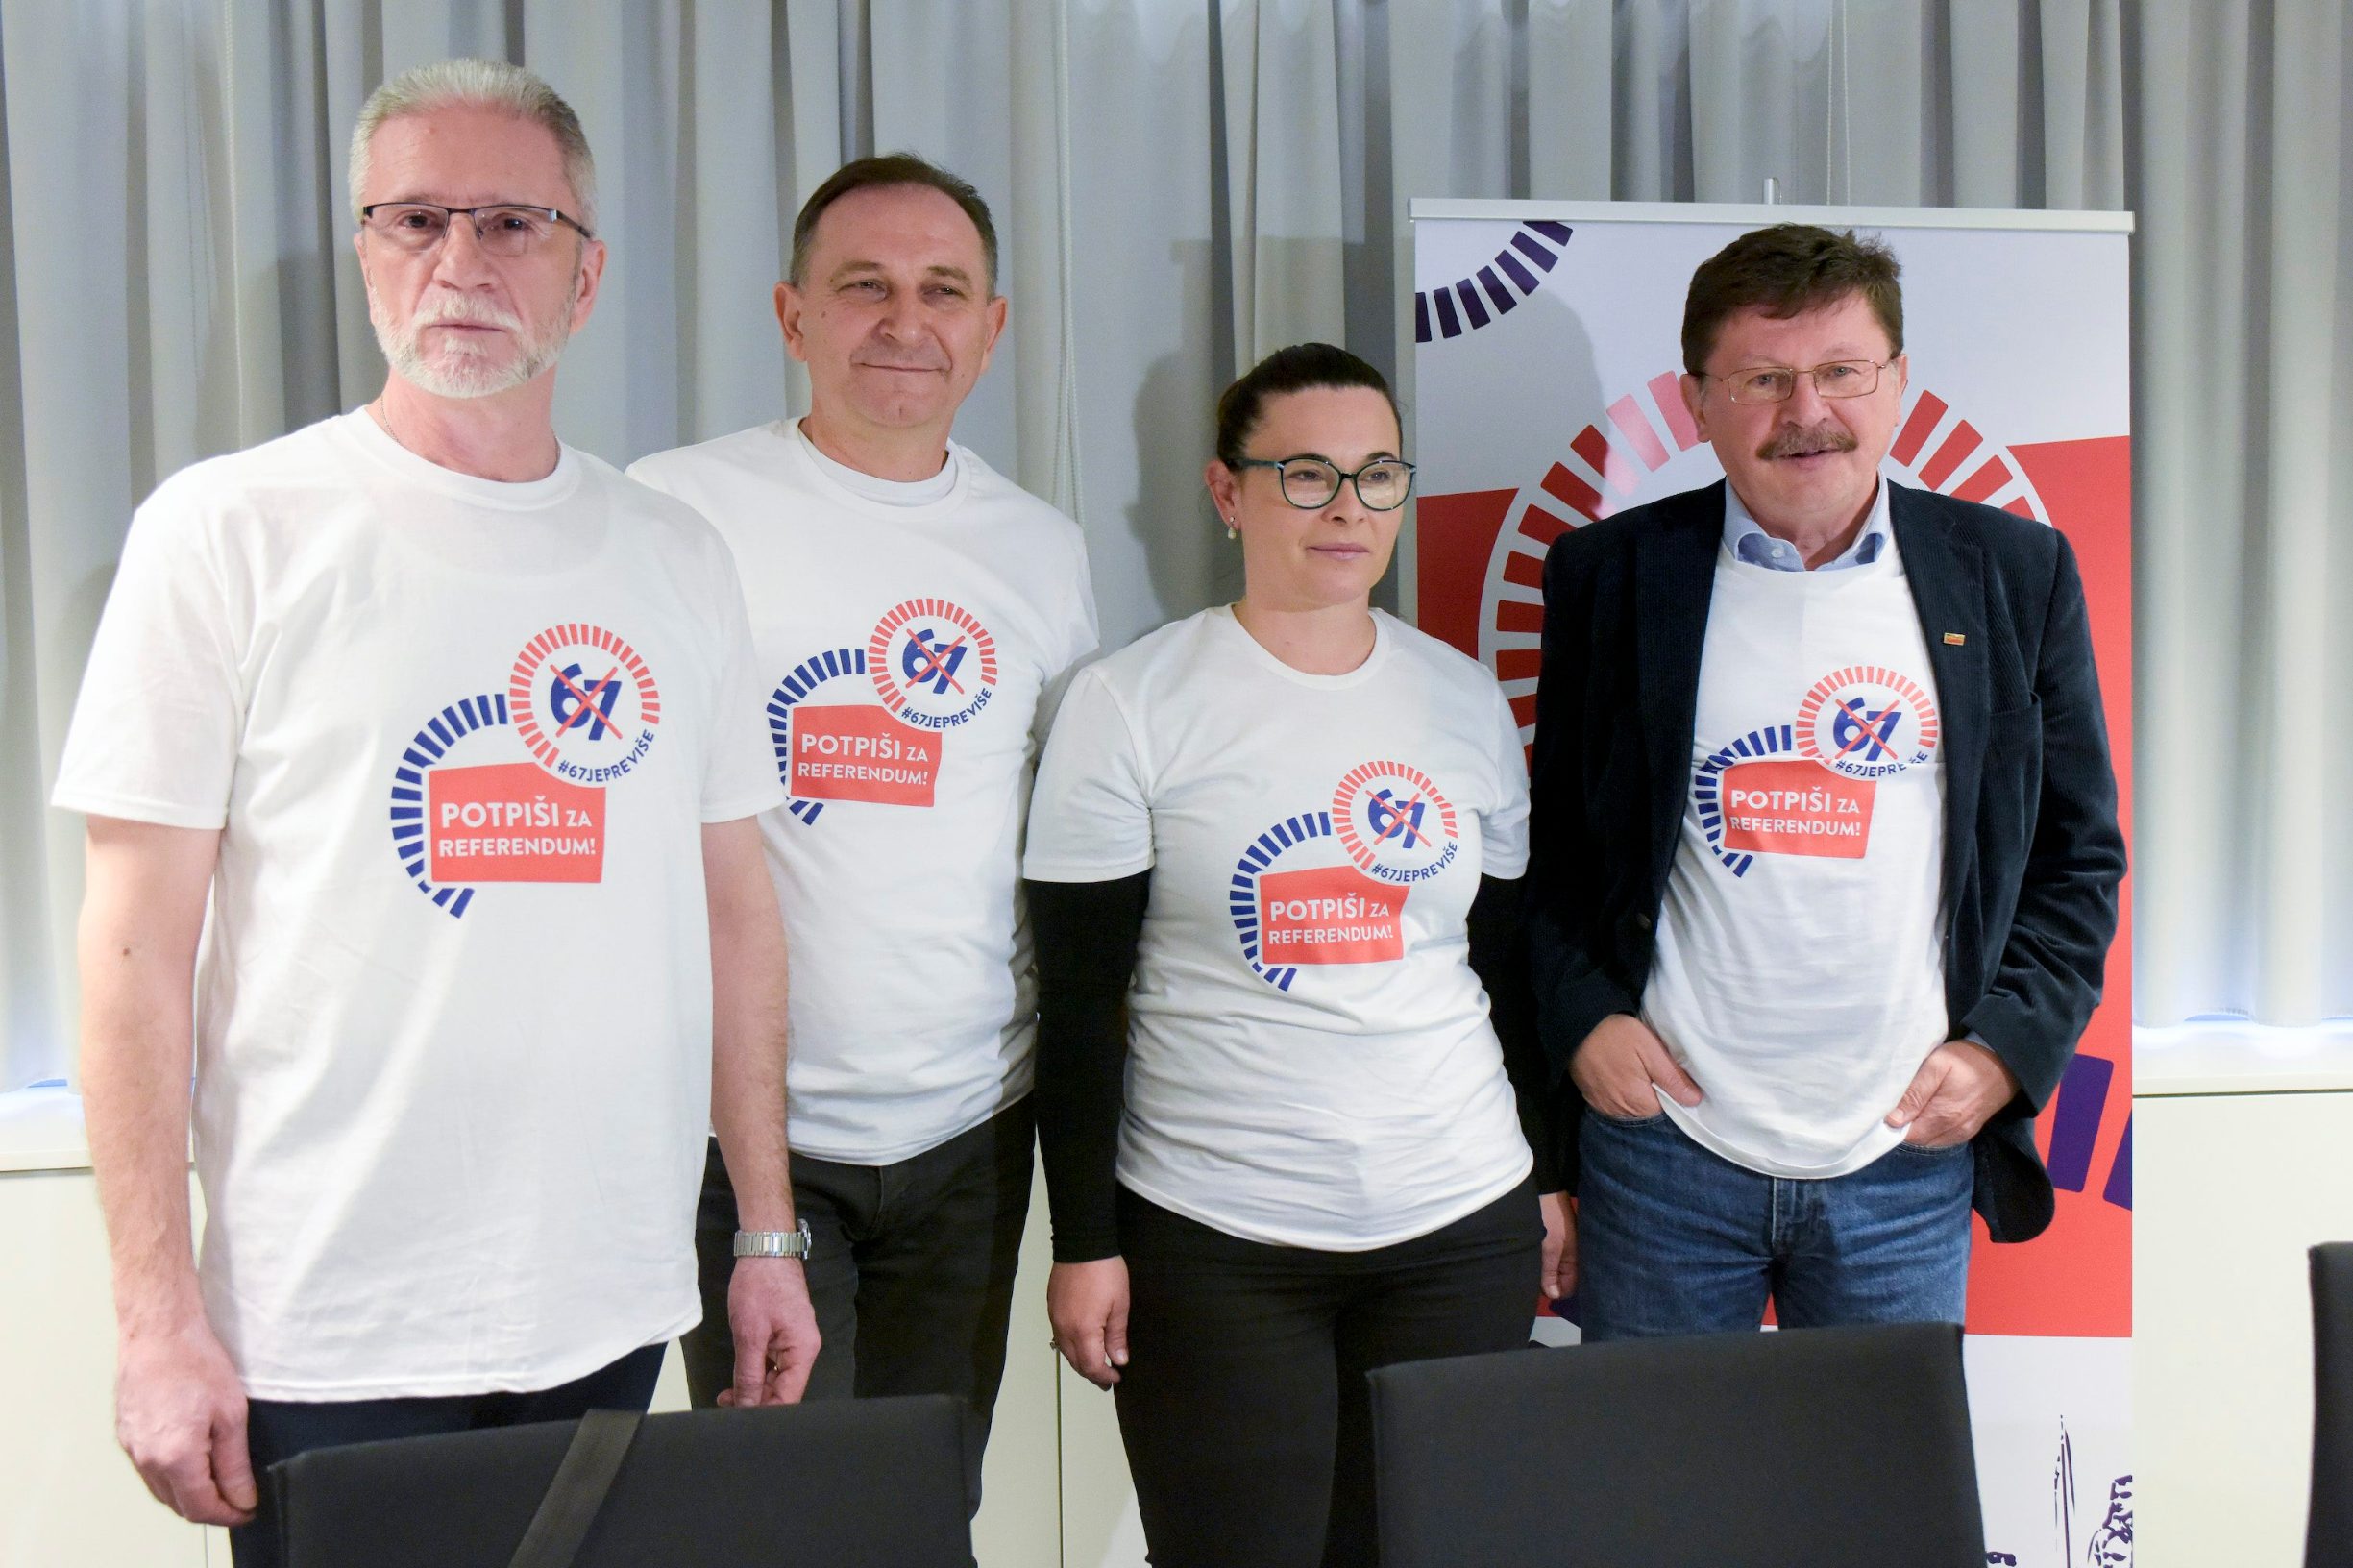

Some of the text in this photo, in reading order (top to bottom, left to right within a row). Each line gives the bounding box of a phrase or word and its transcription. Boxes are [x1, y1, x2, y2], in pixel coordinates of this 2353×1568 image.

[902, 628, 968, 694] 67
[550, 663, 622, 740] 67
[901, 688, 992, 728] #67JEPREVIŠE
[1832, 697, 1902, 761] 67
[557, 729, 654, 782] #67JEPREVIŠE
[801, 732, 928, 762] POTPIŠI ZA
[798, 762, 928, 785] REFERENDUM!
[441, 796, 592, 828] POTPIŠI ZA
[1730, 786, 1860, 813] POTPIŠI ZA
[1368, 789, 1426, 848] 67
[1730, 817, 1860, 836] REFERENDUM!
[439, 837, 596, 857] REFERENDUM!
[1372, 842, 1458, 882] #67JEPREVIŠE
[1270, 893, 1389, 921] POTPIŠI ZA
[1268, 924, 1393, 944] REFERENDUM!
